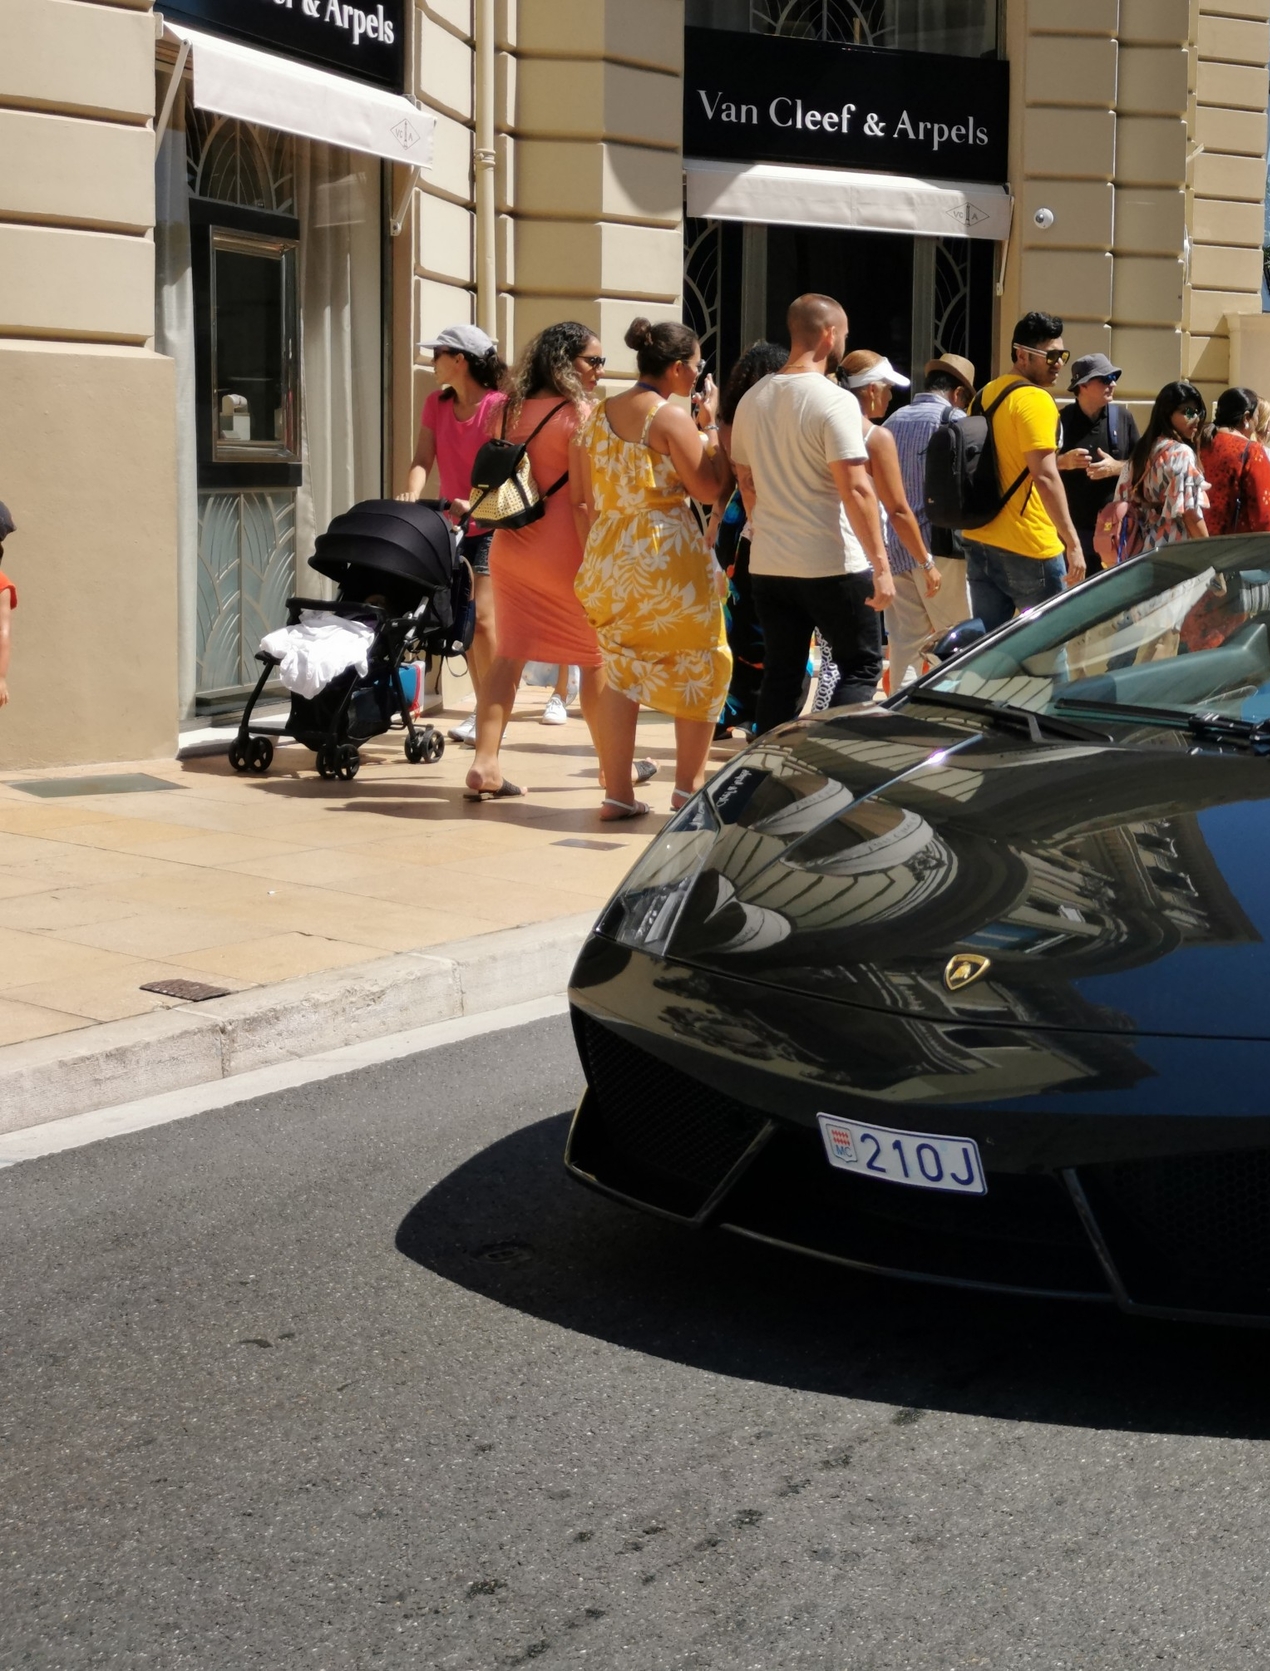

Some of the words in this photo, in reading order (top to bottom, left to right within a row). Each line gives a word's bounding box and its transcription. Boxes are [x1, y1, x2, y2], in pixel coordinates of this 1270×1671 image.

[324, 0, 395, 45] Arpels
[697, 89, 759, 125] Van
[769, 96, 856, 133] Cleef
[863, 112, 886, 137] &
[893, 110, 989, 151] Arpels
[835, 1144, 853, 1158] MC
[860, 1133, 975, 1186] 210J
